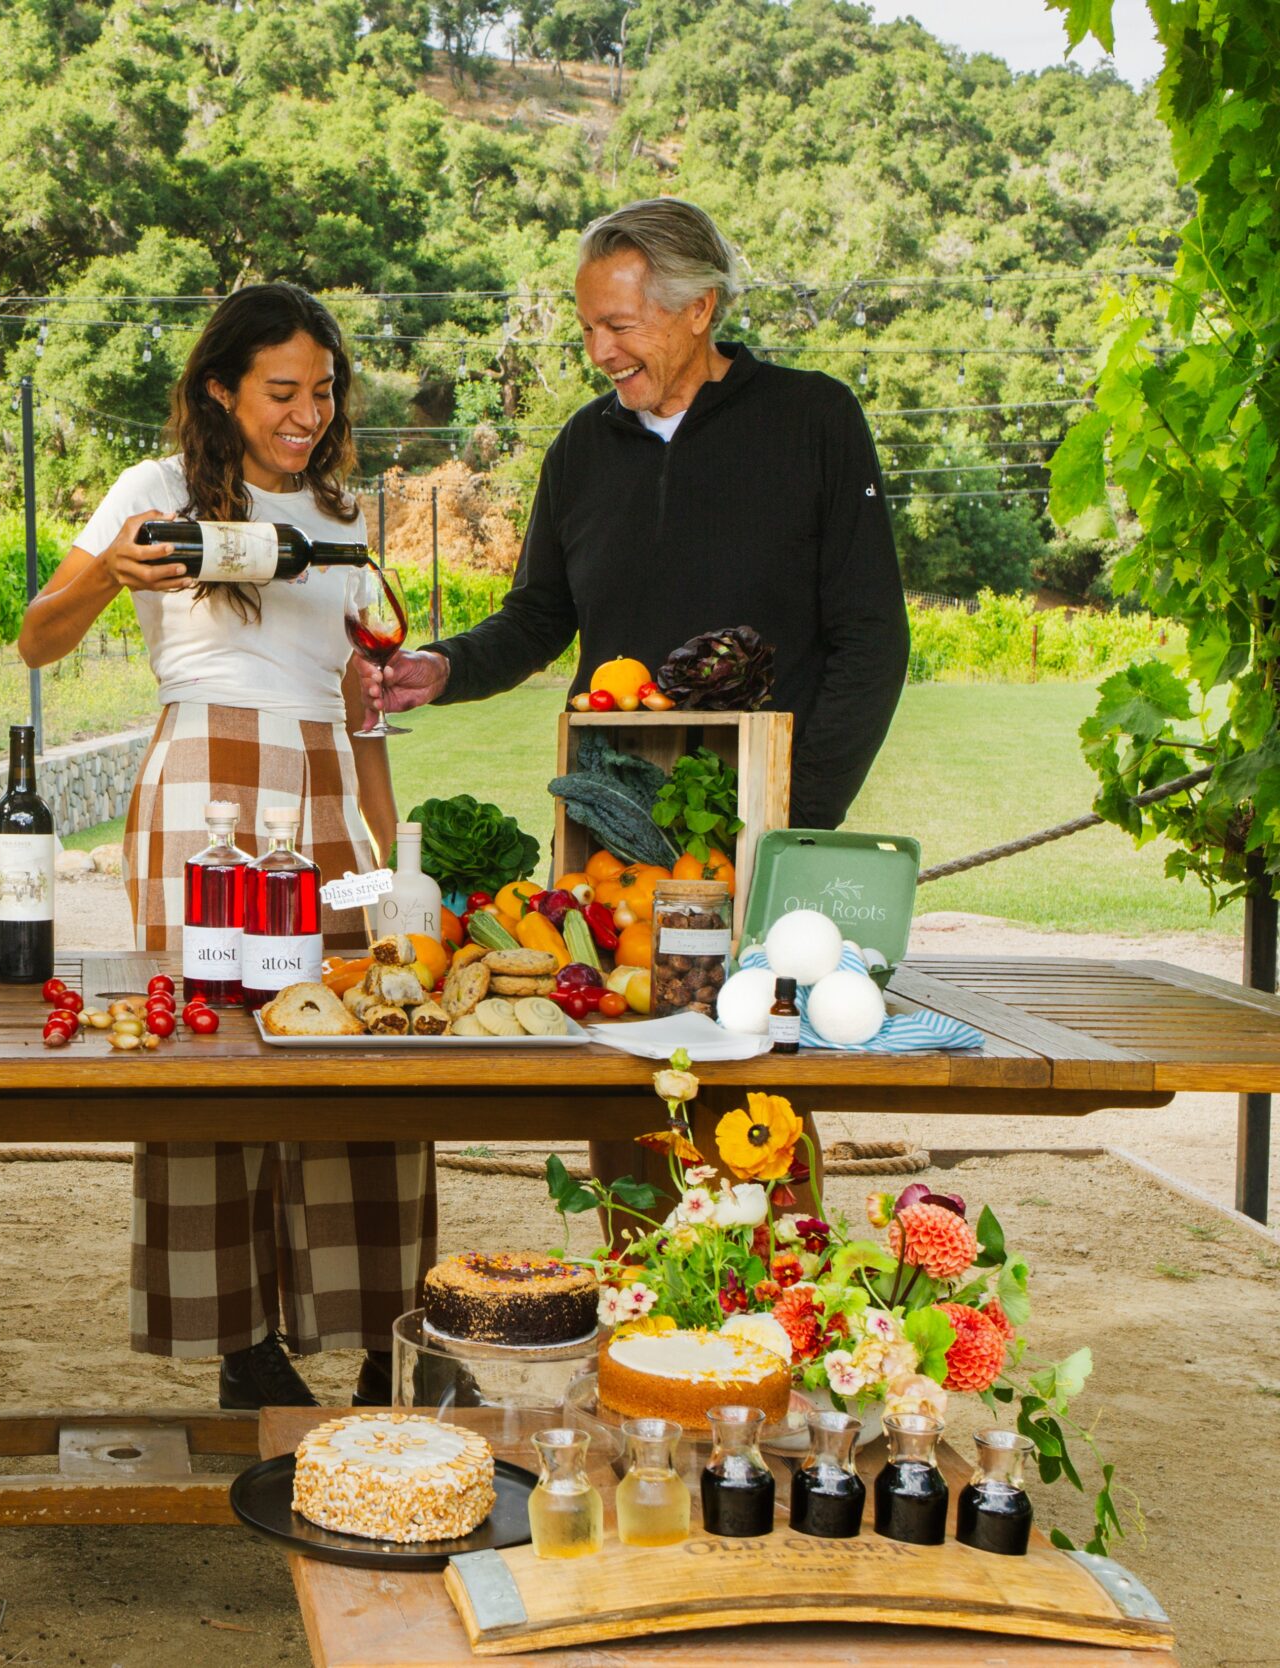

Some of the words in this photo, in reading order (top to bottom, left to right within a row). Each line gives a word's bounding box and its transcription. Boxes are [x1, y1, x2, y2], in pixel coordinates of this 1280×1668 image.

[323, 886, 353, 900] bliss
[383, 900, 398, 919] O
[832, 900, 886, 921] Roots
[423, 911, 434, 931] R
[683, 1538, 767, 1555] OLD
[784, 1538, 919, 1557] CREEK
